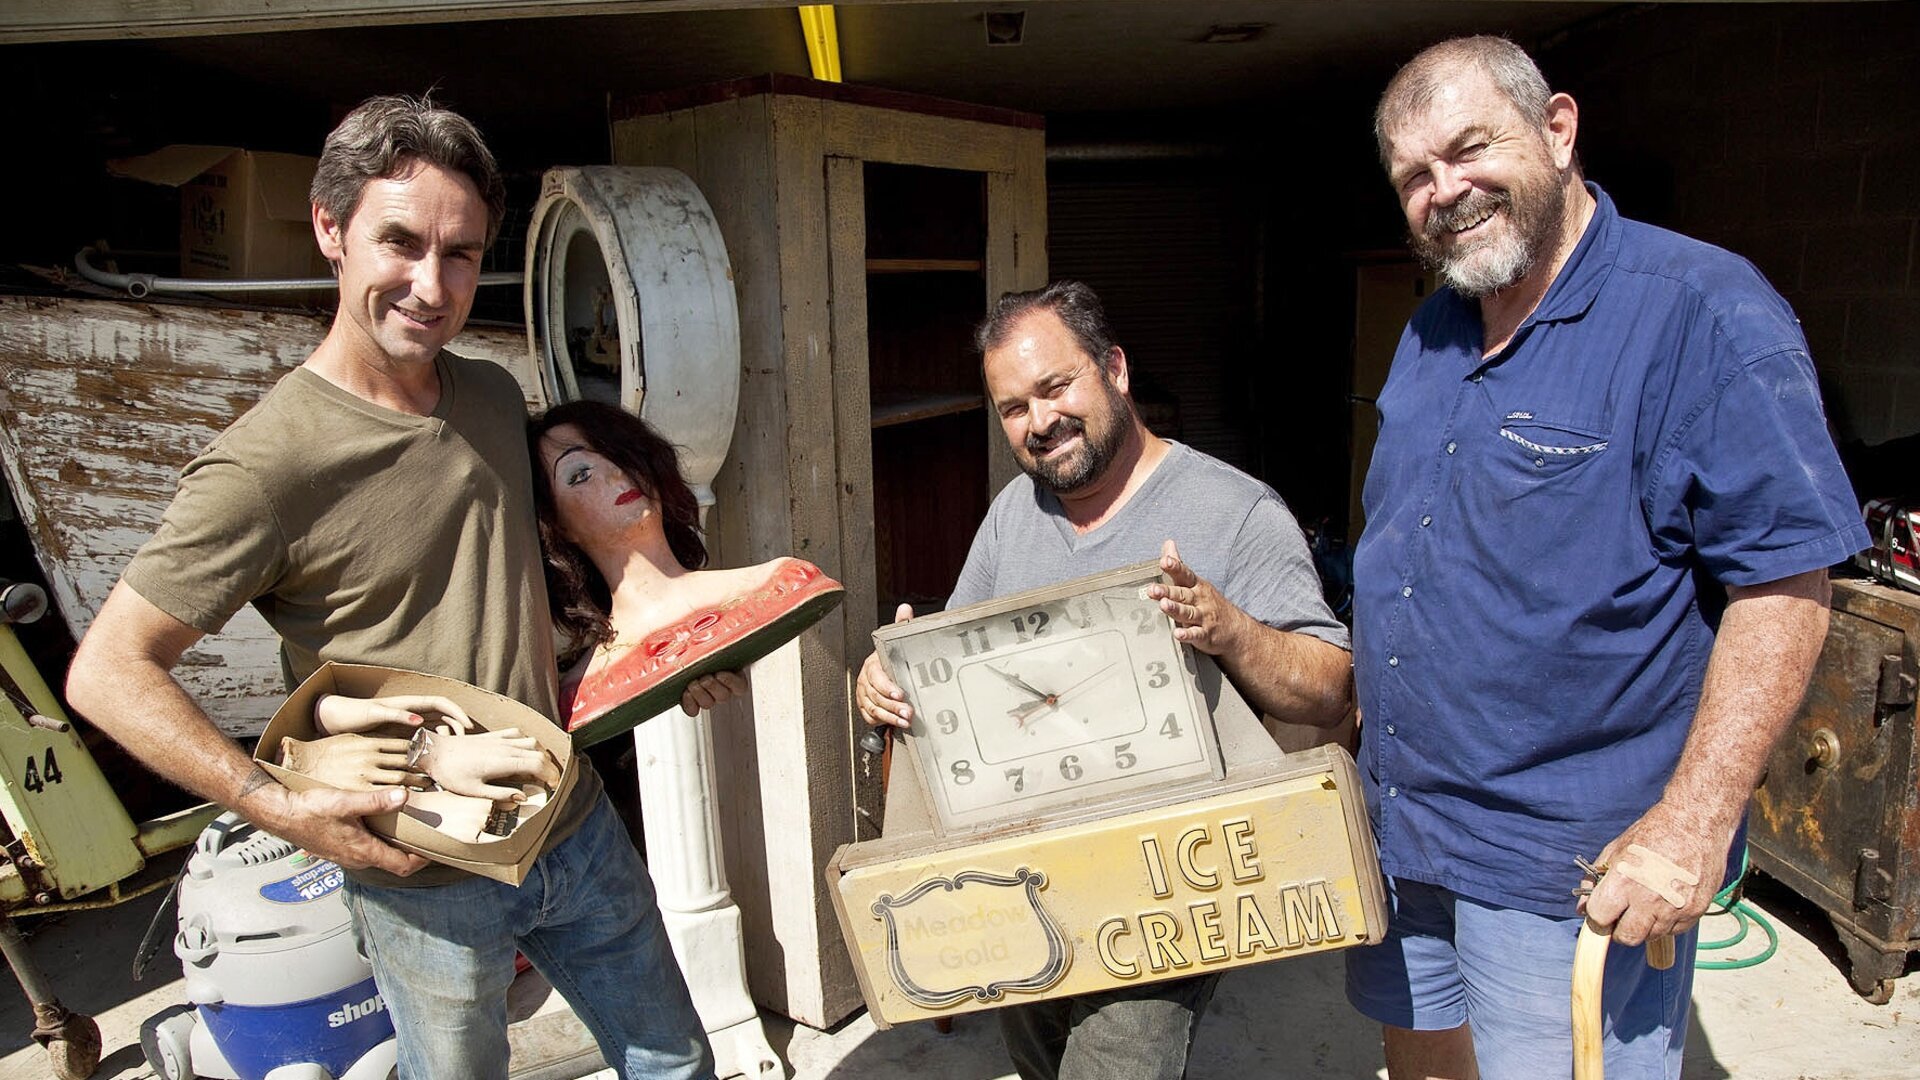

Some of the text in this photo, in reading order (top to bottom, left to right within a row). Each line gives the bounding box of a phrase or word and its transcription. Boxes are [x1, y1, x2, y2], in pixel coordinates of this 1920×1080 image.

[1010, 611, 1050, 645] 12
[1129, 607, 1156, 636] 2
[957, 625, 995, 658] 11
[913, 657, 953, 689] 10
[1145, 661, 1171, 689] 3
[936, 709, 959, 735] 9
[1158, 712, 1184, 740] 4
[24, 747, 63, 794] 44
[1059, 755, 1084, 782] 6
[1114, 742, 1137, 770] 5
[950, 760, 976, 786] 8
[1004, 766, 1025, 793] 7
[1140, 817, 1264, 898] ICE
[904, 904, 1029, 941] Meadow
[1096, 879, 1343, 978] CREAM
[938, 937, 1009, 969] Gold
